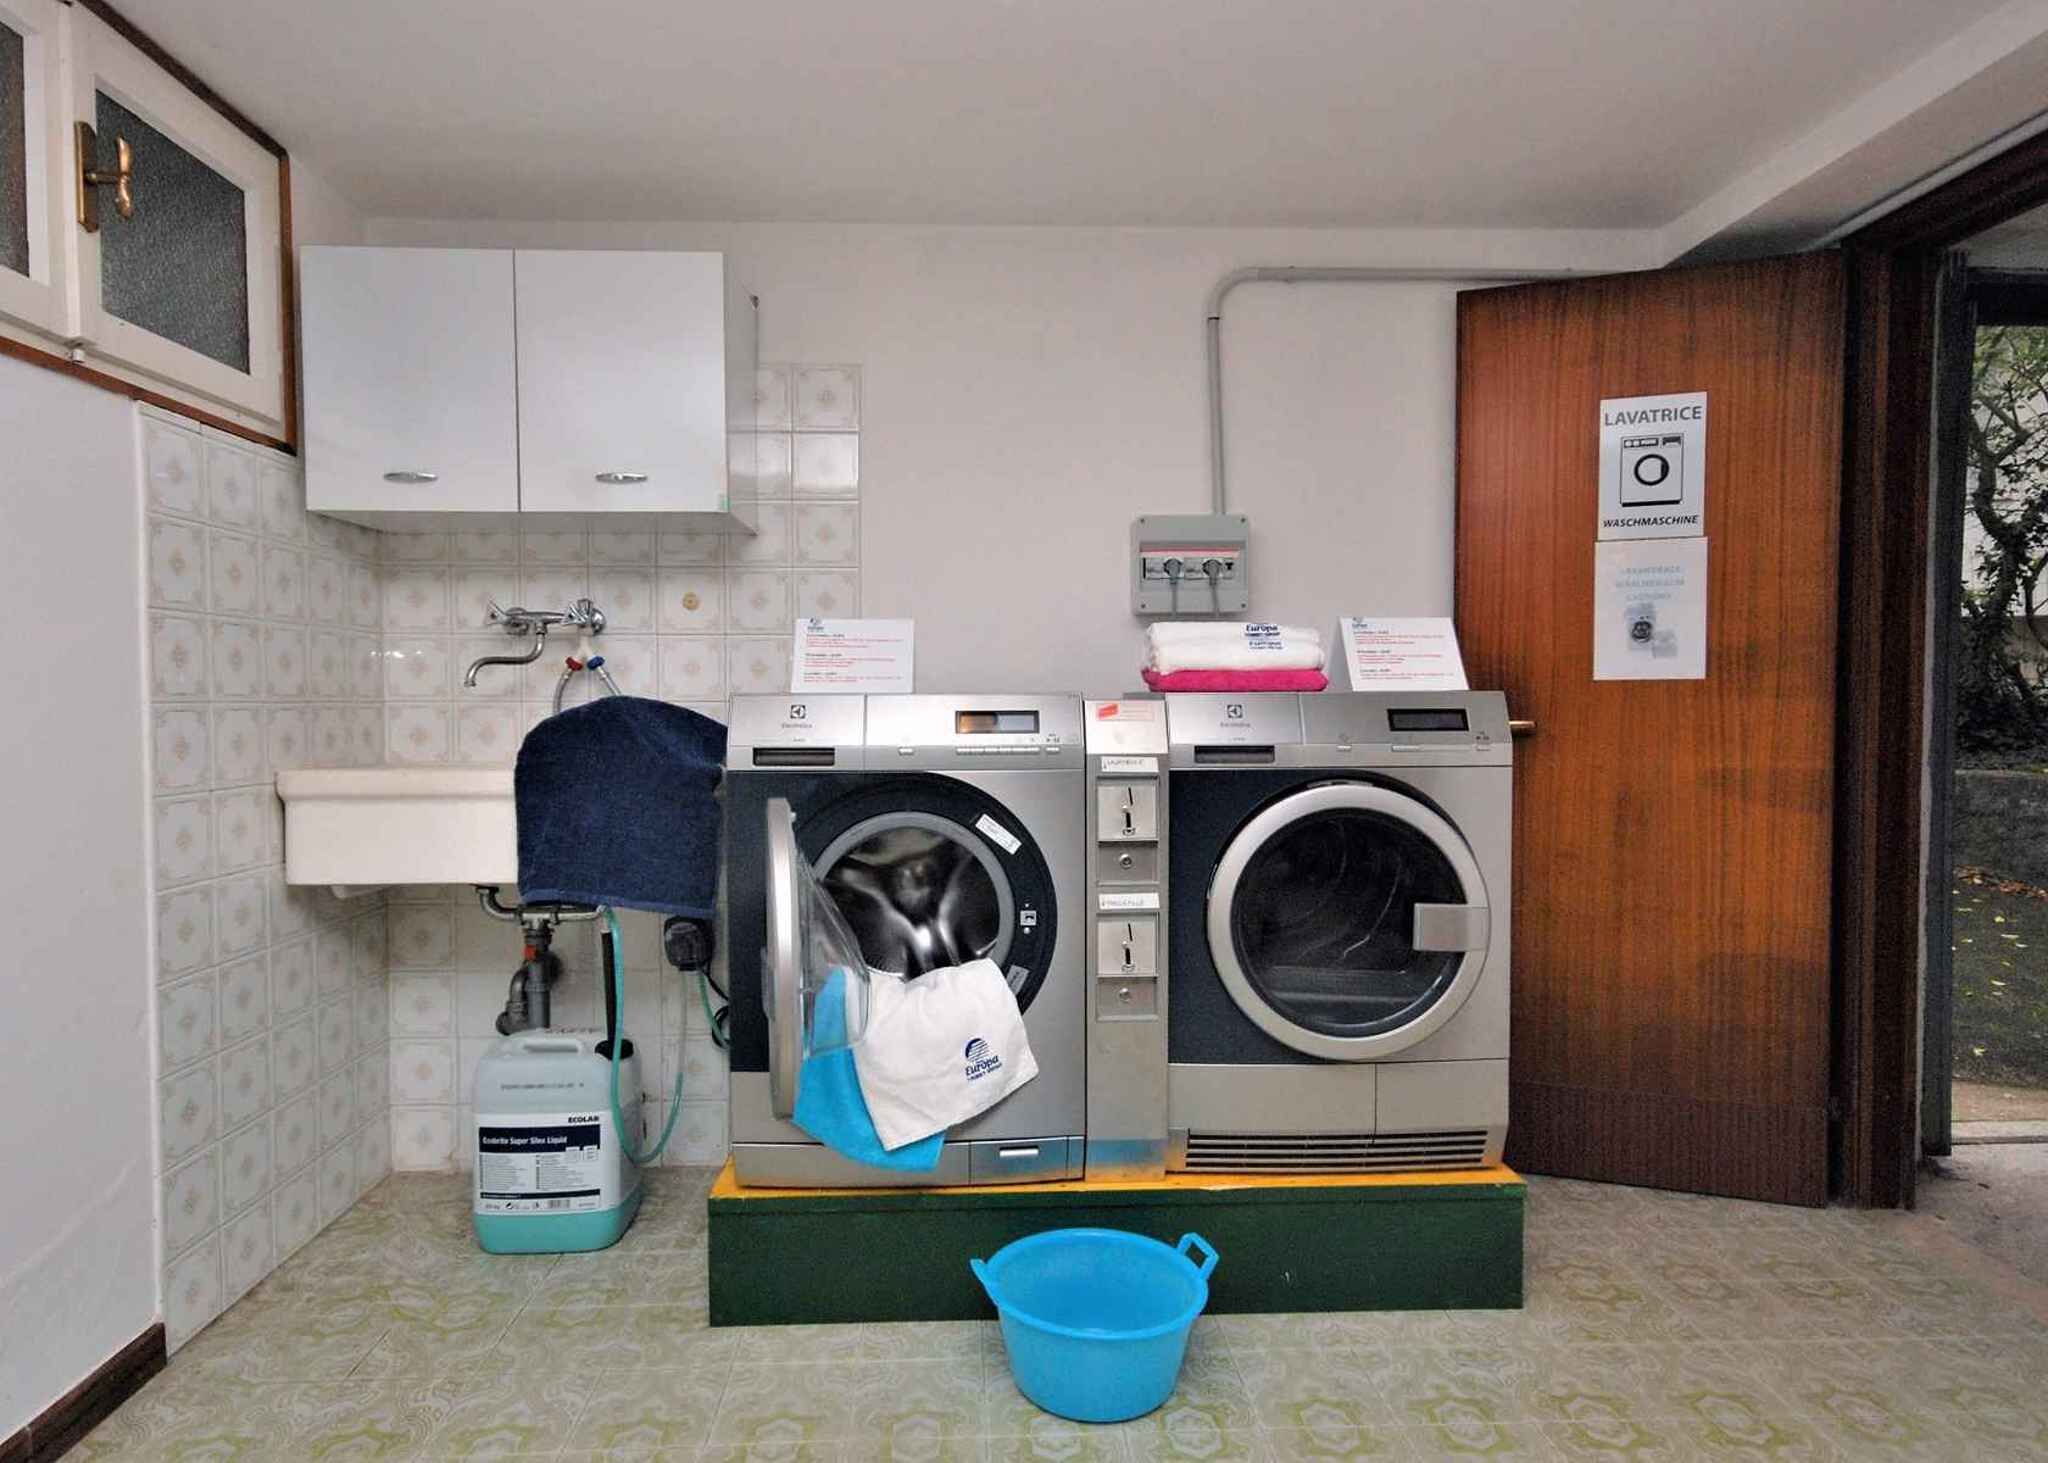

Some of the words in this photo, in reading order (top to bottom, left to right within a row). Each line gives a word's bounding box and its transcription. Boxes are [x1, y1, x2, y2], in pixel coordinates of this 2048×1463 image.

[1604, 405, 1702, 426] LAVATRICE
[1603, 514, 1698, 528] WASCHMASCHINE
[965, 1055, 999, 1077] Europa
[568, 1115, 599, 1124] ECOLAB
